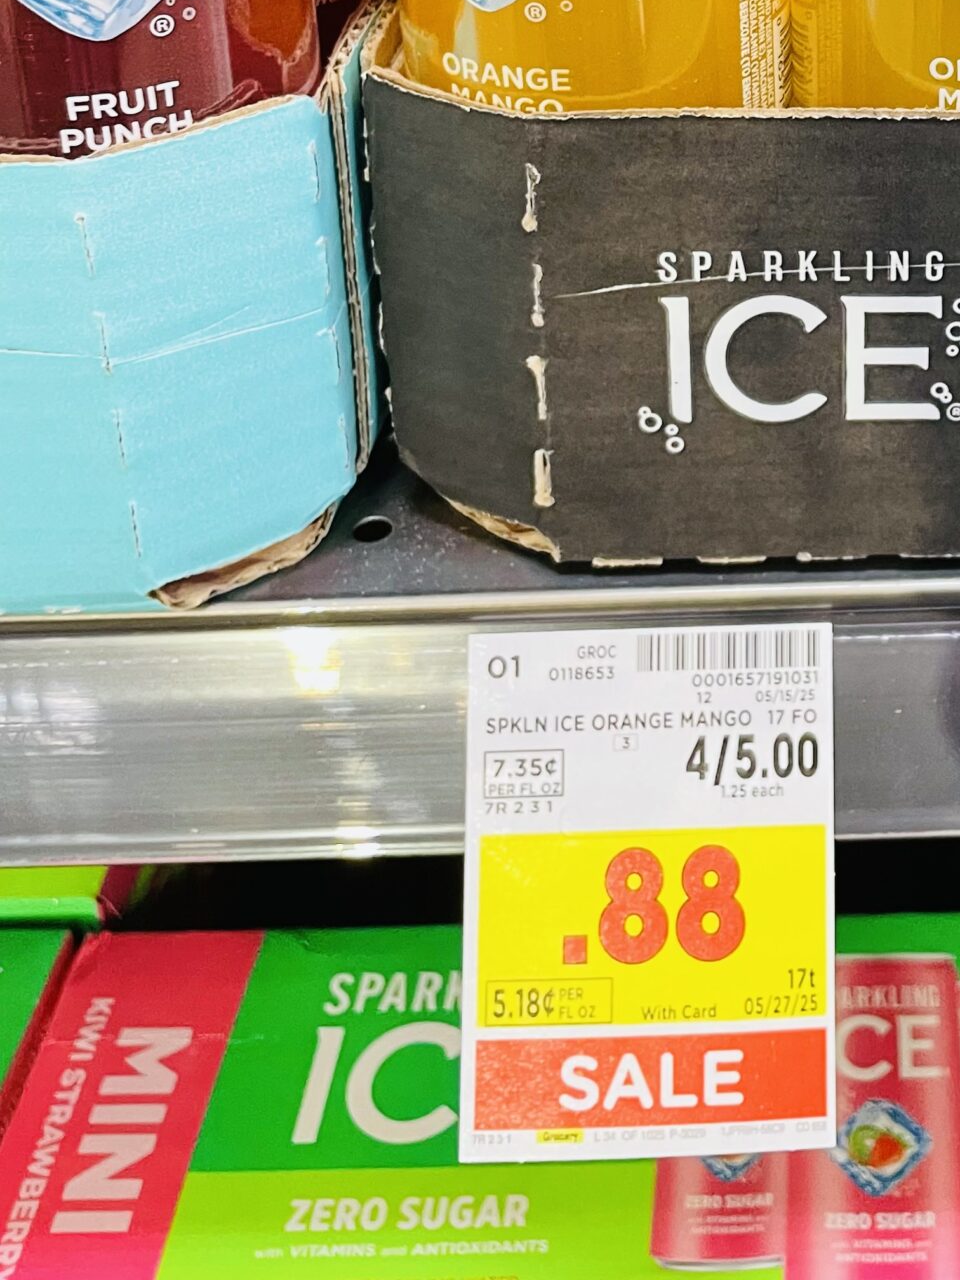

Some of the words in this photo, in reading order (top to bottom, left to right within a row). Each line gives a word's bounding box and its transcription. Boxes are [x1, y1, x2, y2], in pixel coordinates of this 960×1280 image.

[739, 1, 750, 58] BENZOATE
[765, 16, 773, 75] VEGETABLE
[442, 52, 572, 92] ORANGE
[741, 58, 751, 76] (TO
[66, 80, 180, 121] FRUIT
[60, 109, 193, 154] PUNCH
[657, 250, 945, 282] SPARKLING
[658, 294, 943, 424] ICE
[577, 645, 616, 659] GROC
[549, 667, 615, 681] 0118653
[692, 671, 819, 687] 0001657191031
[697, 691, 712, 704] 12
[755, 689, 815, 703] 05/15/25
[487, 717, 547, 734] SPKLN
[555, 715, 585, 732] ICE
[592, 712, 673, 731] ORANGE
[681, 710, 752, 728] MANGO
[768, 710, 785, 725] 17
[792, 709, 817, 724] FO
[621, 737, 631, 750] 3
[493, 758, 558, 778] 7.35¢
[686, 731, 819, 786] 4/5.00
[488, 783, 516, 797] PER
[520, 783, 537, 796] FL
[540, 781, 561, 795] OZ
[720, 785, 747, 799] 1.25
[751, 784, 784, 798] each
[485, 801, 508, 815] 7R
[514, 801, 524, 814] 2
[530, 801, 540, 814] 3
[562, 844, 746, 965] .88
[493, 987, 555, 1018] 5.18¢
[559, 988, 584, 1000] PER
[558, 1007, 575, 1019] FL
[578, 1006, 597, 1018] OZ
[641, 1006, 676, 1020] With
[682, 1004, 717, 1019] Card
[744, 993, 818, 1016] 05/27/25
[70, 997, 115, 1062] KIWI
[558, 1049, 745, 1111] SALE
[50, 1026, 193, 1234] MINI
[285, 1197, 387, 1233] ZERO
[397, 1195, 530, 1231] SUGAR
[875, 1210, 936, 1229] SUGAR
[290, 1242, 376, 1258] VITAMINS
[411, 1240, 549, 1256] ANTIOXIDANTS
